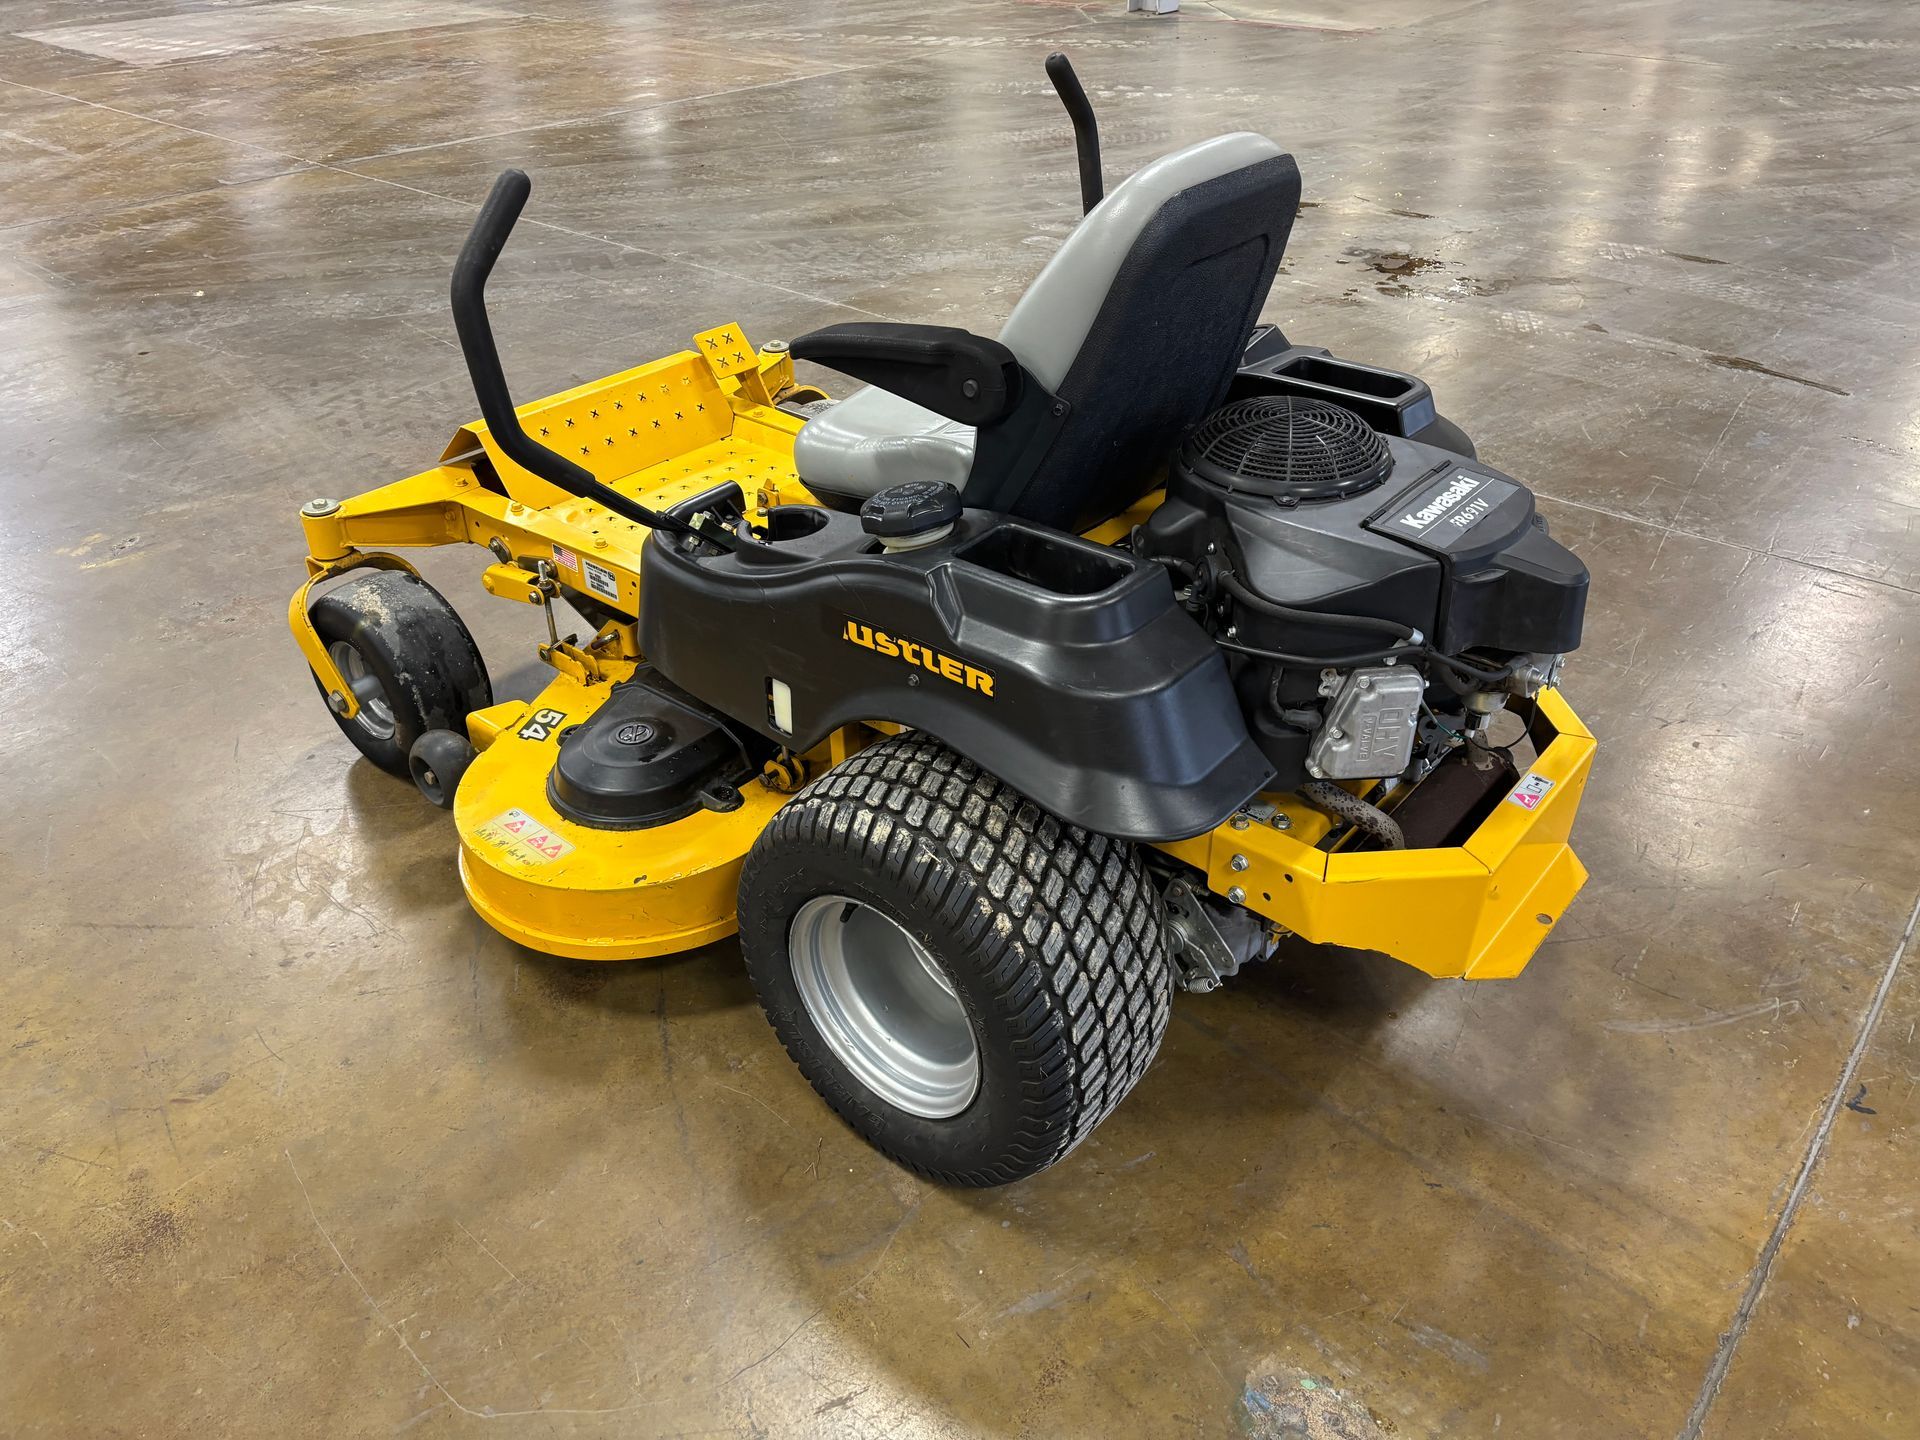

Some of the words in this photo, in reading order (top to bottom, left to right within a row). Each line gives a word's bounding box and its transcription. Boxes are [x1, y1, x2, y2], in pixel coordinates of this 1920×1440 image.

[1400, 475, 1480, 529] Kawasaki
[843, 621, 994, 697] USTLER
[519, 708, 565, 740] 54
